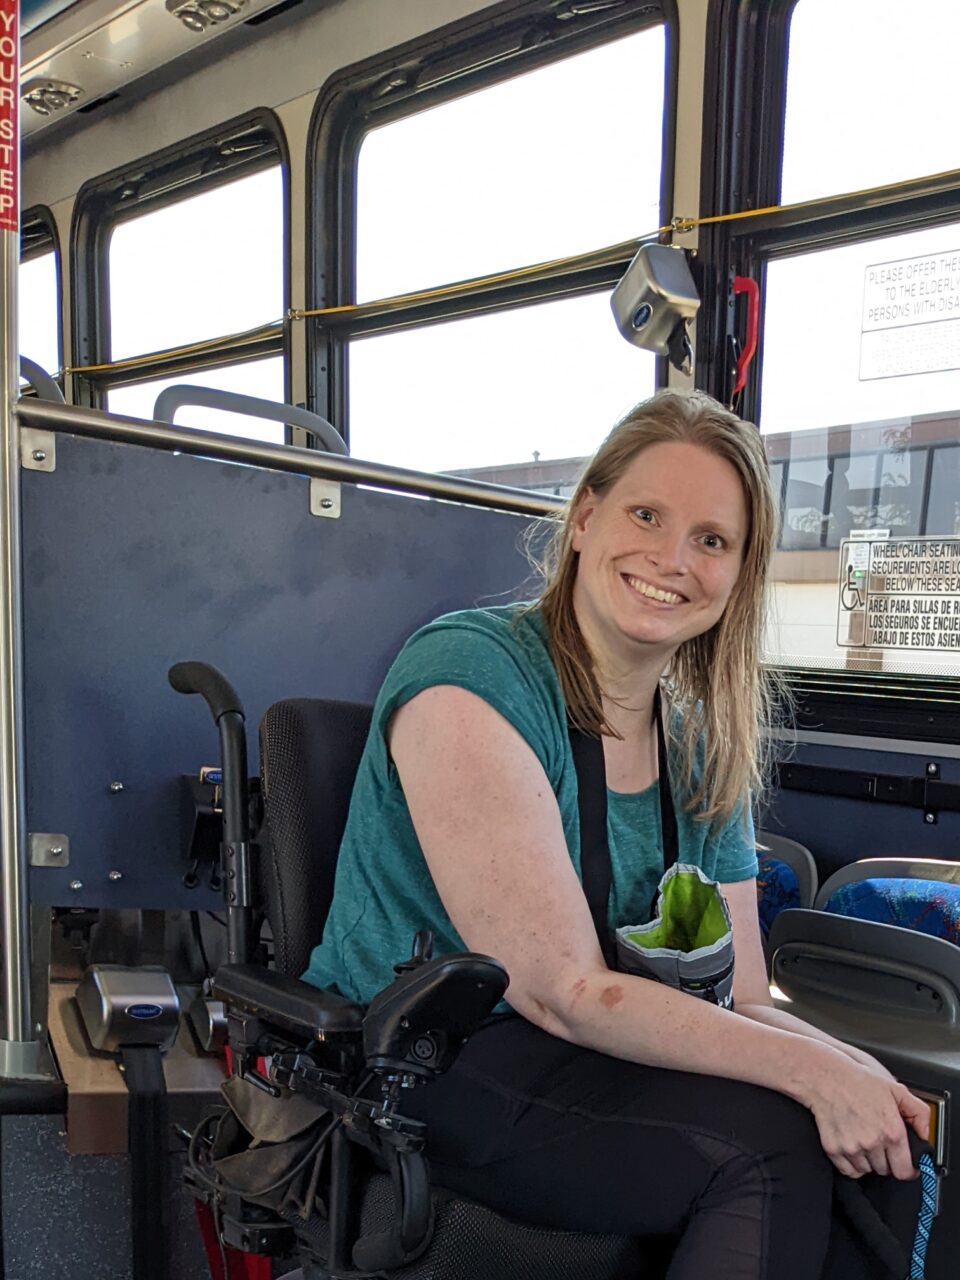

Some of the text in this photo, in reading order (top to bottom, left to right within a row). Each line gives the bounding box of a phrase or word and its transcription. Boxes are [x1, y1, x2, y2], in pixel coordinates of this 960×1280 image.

[0, 10, 15, 109] YOUR
[0, 119, 14, 214] STEP
[869, 267, 903, 285] PLEASE
[906, 261, 936, 280] OFFER
[885, 287, 897, 301] TO
[900, 283, 916, 297] THE
[919, 277, 960, 296] ELDERLY
[868, 303, 910, 322] PERSONS
[914, 300, 935, 315] WITH
[873, 545, 900, 558] WHEEL
[902, 545, 927, 558] CHAIR
[872, 561, 931, 574] SECUREMENTS
[933, 561, 950, 574] ARE
[885, 578, 914, 591] BELOW
[916, 578, 942, 591] THESE
[868, 596, 888, 613] ÁREA
[890, 600, 910, 613] PARA
[913, 600, 939, 614] SILLAS
[941, 600, 951, 614] DE
[869, 615, 883, 628] LOS
[885, 616, 919, 629] SEGUROS
[921, 616, 931, 630] SE
[873, 631, 897, 645] ABAJO
[899, 632, 909, 645] DE
[911, 633, 935, 646] ESTOS
